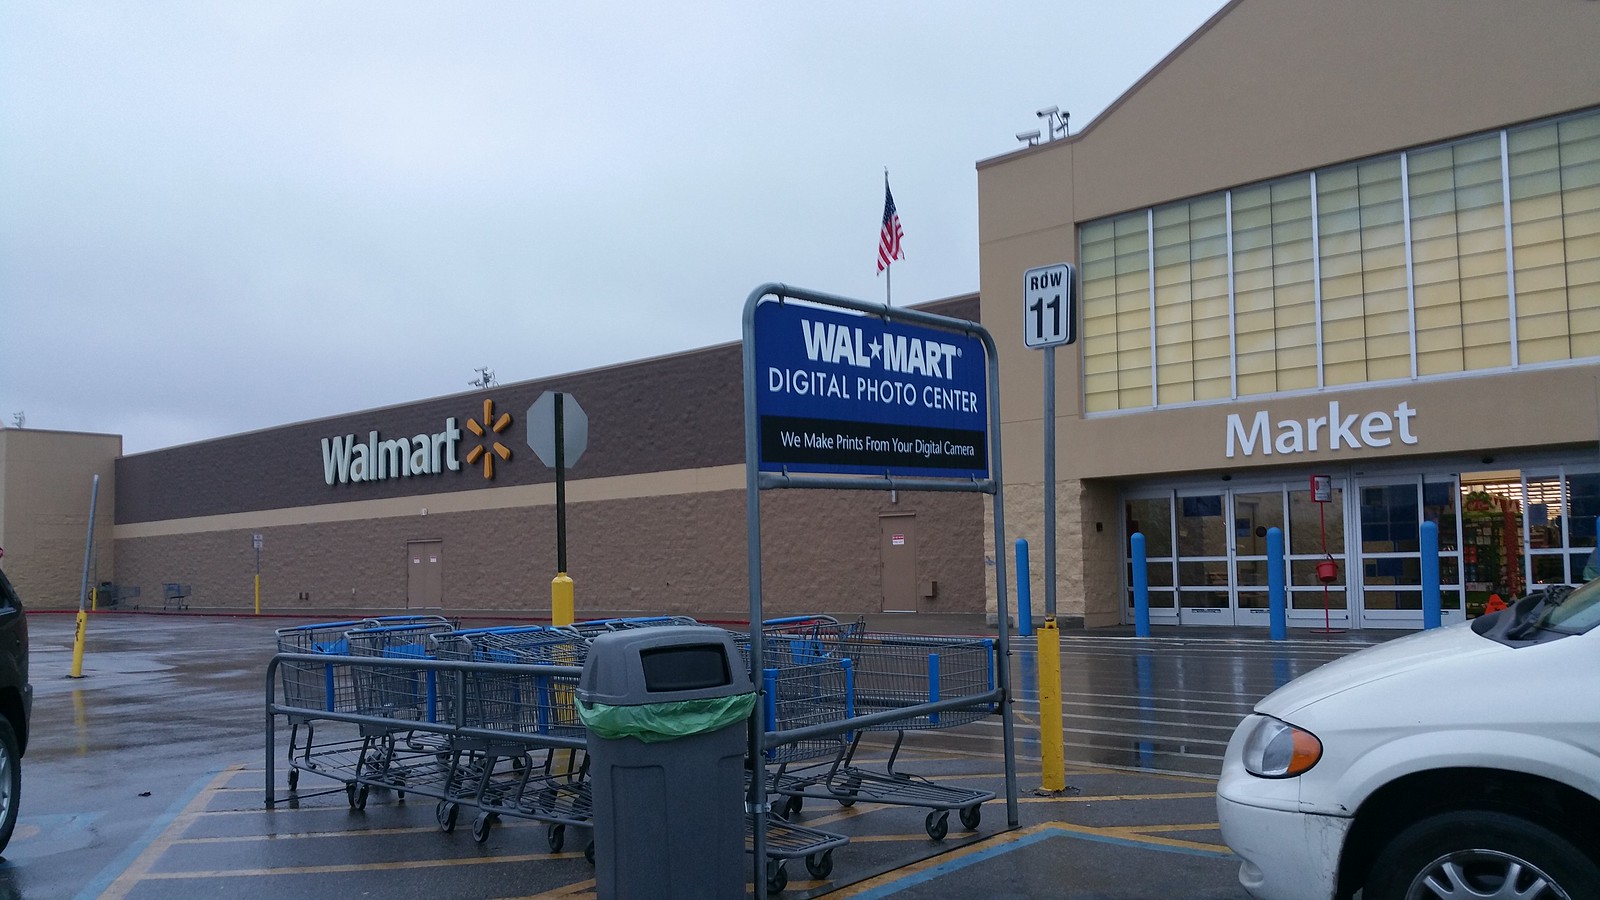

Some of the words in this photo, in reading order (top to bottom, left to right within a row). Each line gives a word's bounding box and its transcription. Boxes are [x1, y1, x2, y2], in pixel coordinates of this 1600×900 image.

[1031, 271, 1062, 291] ROW
[1030, 294, 1060, 338] 11
[769, 366, 850, 399] DIGITAL
[857, 377, 917, 406] PHOTO
[923, 385, 978, 413] CENTER
[321, 417, 460, 485] Walmart
[780, 430, 801, 447] We
[804, 432, 834, 449] Make
[836, 434, 863, 450] Prints
[865, 436, 890, 452] From
[892, 437, 913, 453] Your
[915, 439, 942, 458] Digital
[944, 440, 975, 456] Camera
[1225, 400, 1418, 457] Market
